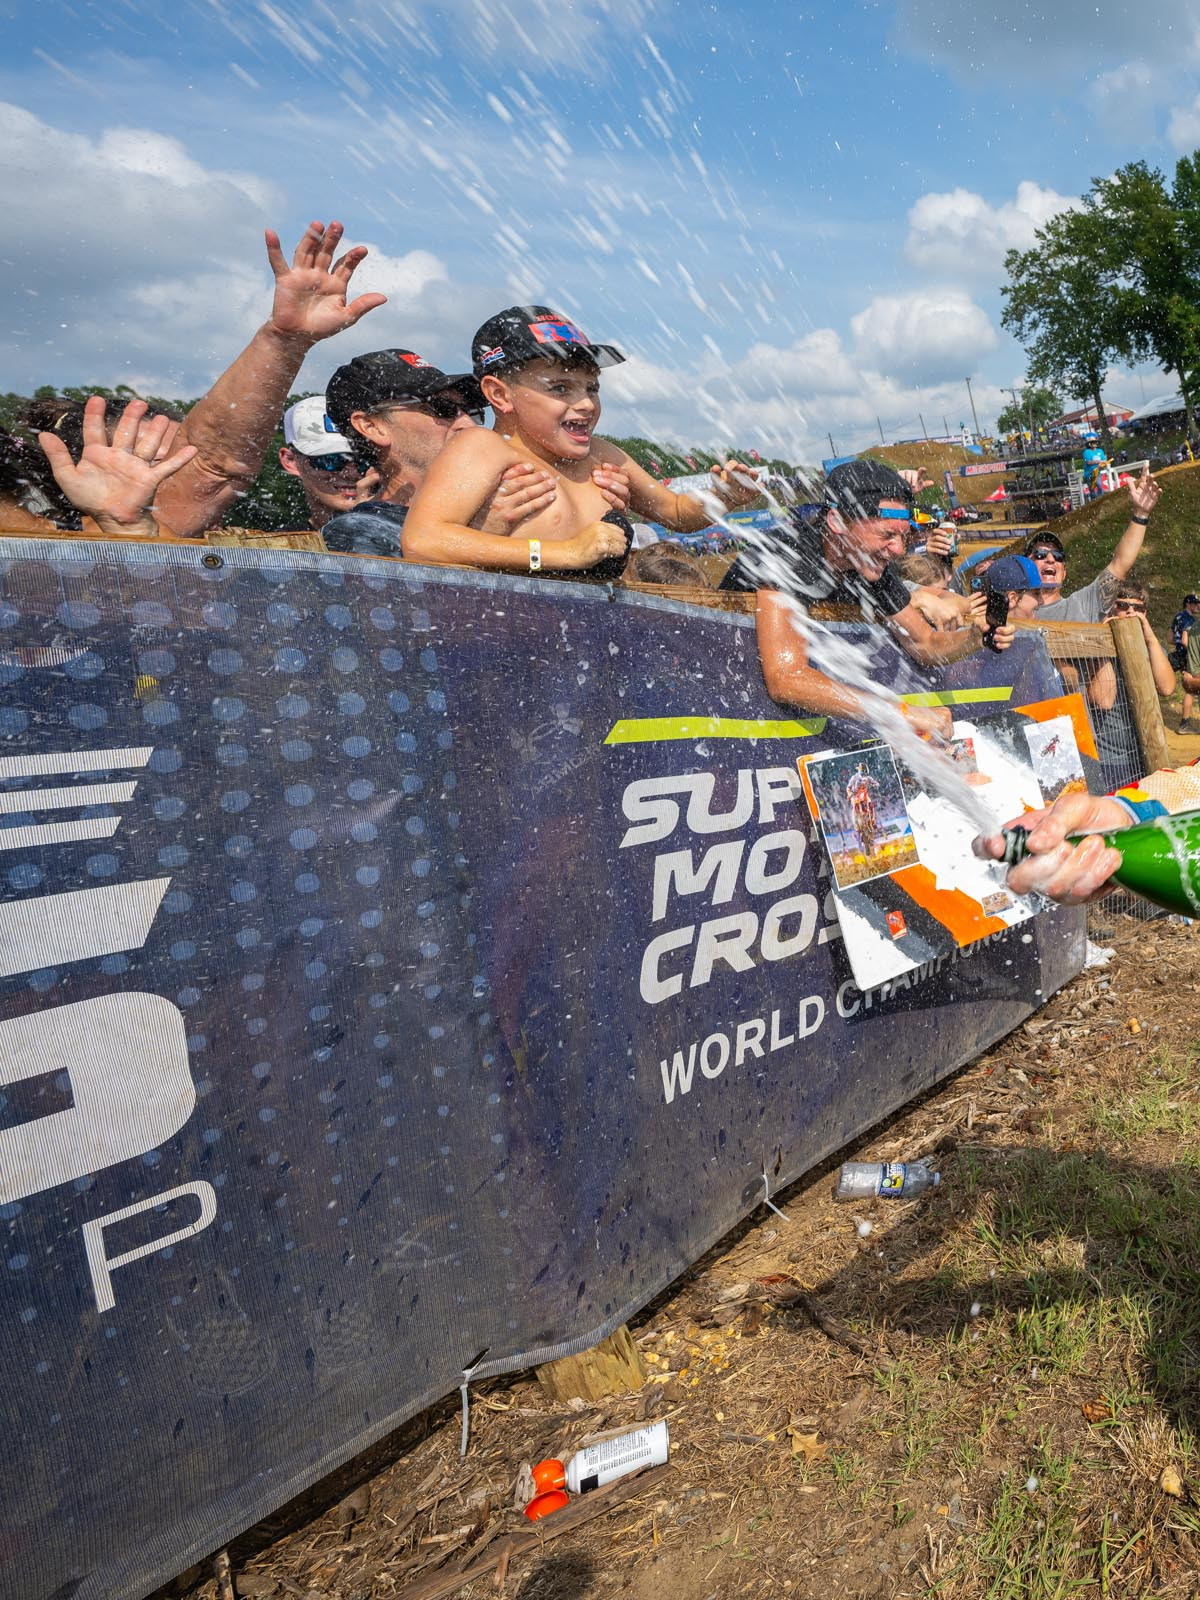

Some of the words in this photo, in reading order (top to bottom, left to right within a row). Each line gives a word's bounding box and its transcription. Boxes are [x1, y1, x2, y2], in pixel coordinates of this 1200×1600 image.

[620, 767, 802, 848] SUP
[652, 829, 807, 922] MO
[640, 889, 840, 1004] CRO
[660, 995, 826, 1105] WORLD
